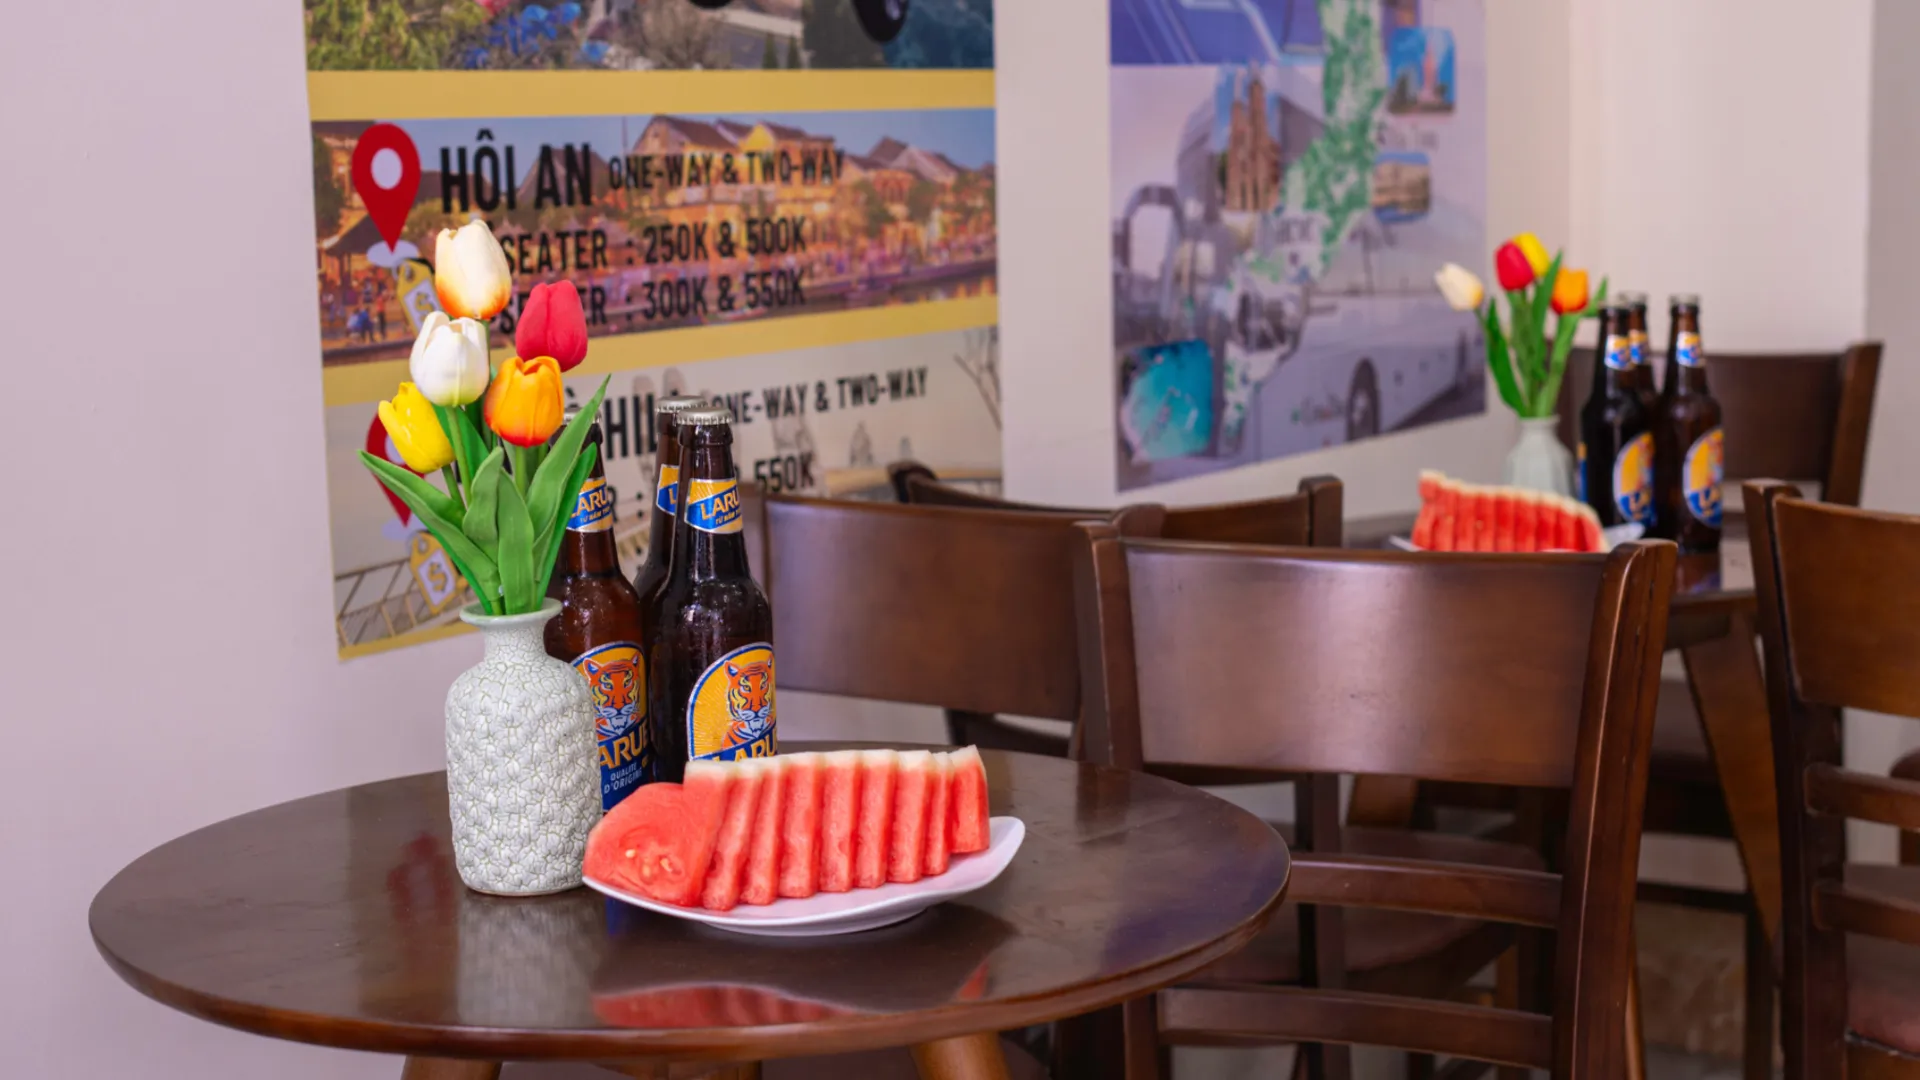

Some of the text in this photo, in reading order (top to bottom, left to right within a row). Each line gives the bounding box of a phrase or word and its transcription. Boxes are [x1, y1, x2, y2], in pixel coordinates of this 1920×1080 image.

[534, 142, 593, 211] AN
[608, 148, 845, 191] ONE-WAY & TWO-WAY
[501, 229, 608, 277] SEATER
[643, 221, 708, 265] 250K
[718, 221, 736, 258] &
[747, 216, 807, 255] 500K
[642, 276, 708, 321] 300K
[717, 275, 736, 312] &
[745, 268, 806, 309] 550K
[604, 392, 660, 461] HIL
[815, 380, 830, 413] &
[837, 367, 928, 410] TWO-WAY
[754, 450, 815, 493] 550K
[701, 489, 740, 520] LARU
[598, 719, 648, 769] ARUE
